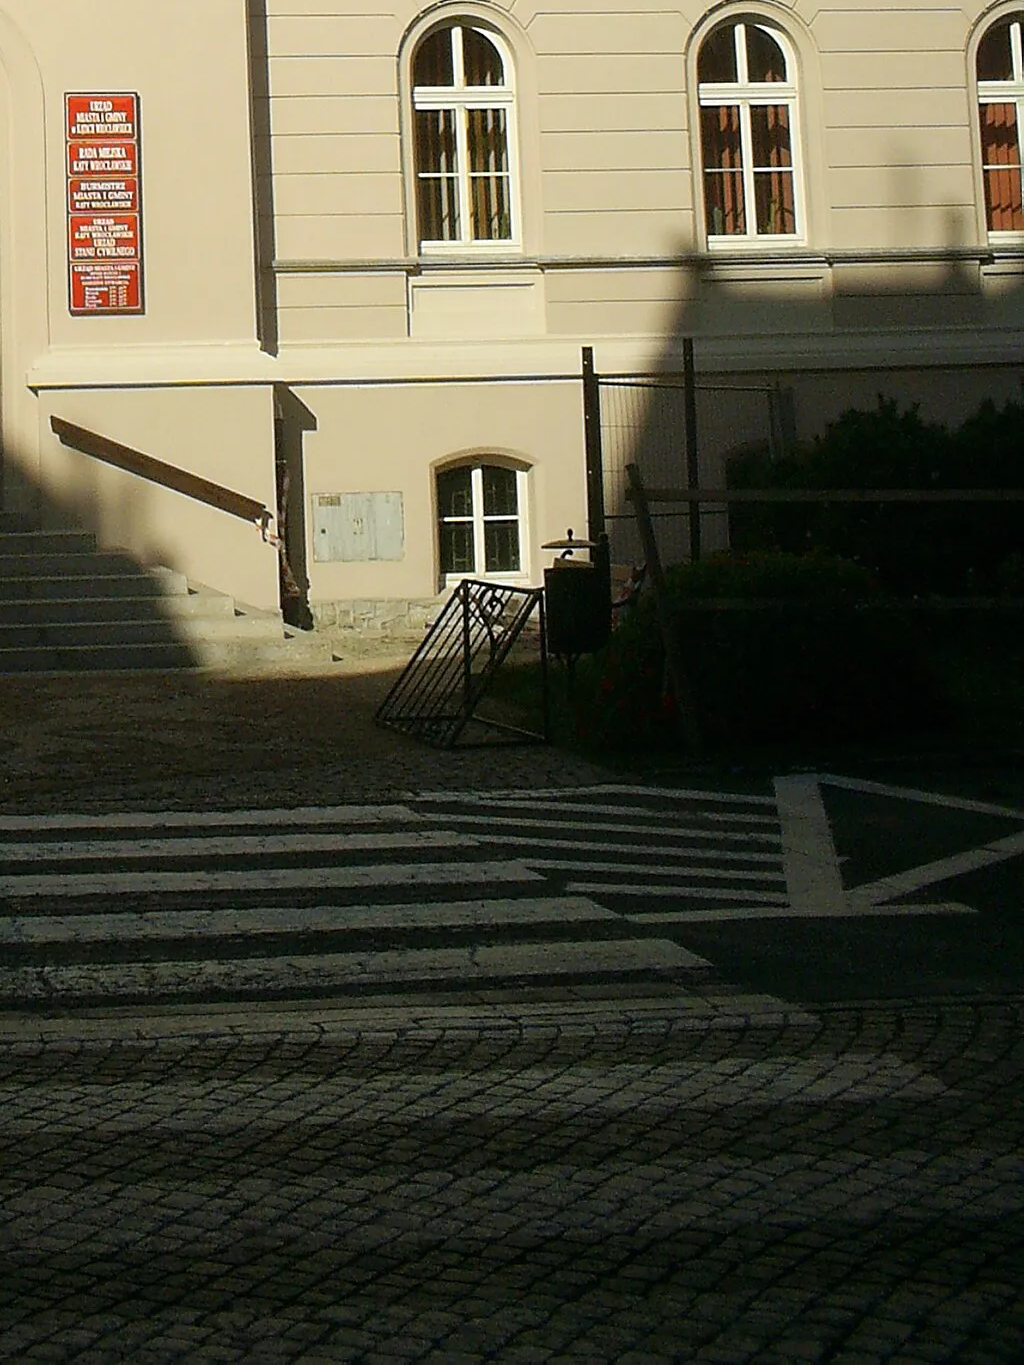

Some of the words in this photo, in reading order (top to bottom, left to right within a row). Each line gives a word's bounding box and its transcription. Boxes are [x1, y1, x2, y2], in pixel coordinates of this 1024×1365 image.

[76, 112, 101, 122] MIASTA
[101, 112, 105, 122] I
[79, 147, 98, 158] RADA
[73, 192, 102, 200] MIASTA
[102, 192, 107, 200] I
[107, 191, 133, 200] GMINY
